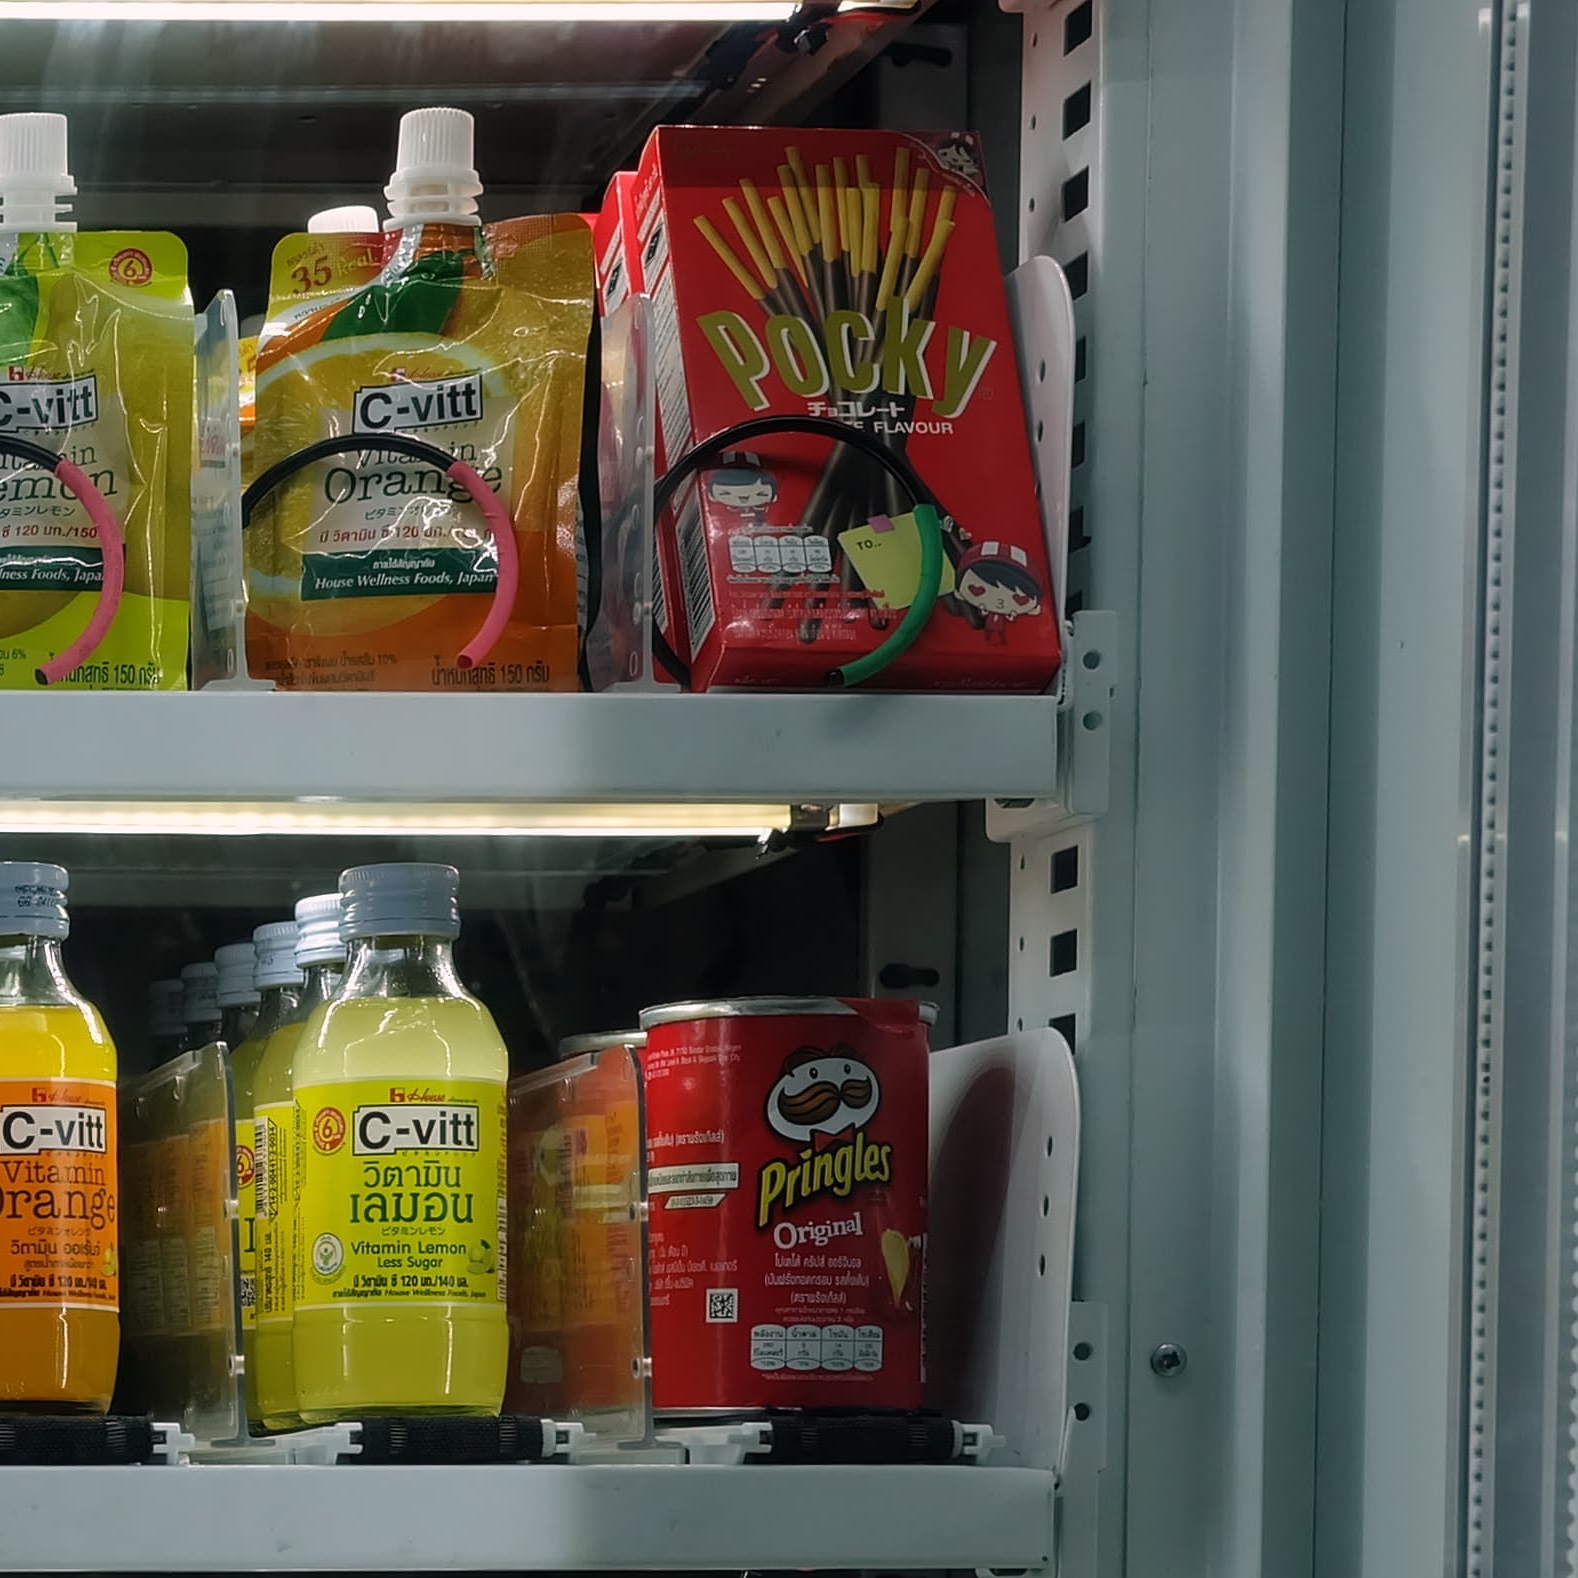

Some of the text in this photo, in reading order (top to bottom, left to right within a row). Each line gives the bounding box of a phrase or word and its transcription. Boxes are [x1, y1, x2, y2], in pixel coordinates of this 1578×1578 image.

[291, 255, 333, 294] 35
[359, 382, 478, 429] C-vitt
[808, 400, 906, 419] チョコレート
[873, 420, 954, 435] FLAVOUR
[15, 524, 38, 536] 120
[333, 526, 419, 542] วิตามิน 120
[31, 568, 71, 583] Foods,
[315, 571, 494, 591] House Wellness Foods, Japan
[114, 665, 135, 683] 150
[500, 666, 523, 685] 150
[407, 1088, 446, 1103] House
[2, 1111, 104, 1150] C-vitt
[359, 1110, 475, 1150] C-vitt
[0, 1160, 106, 1187] Vitamin
[364, 1160, 461, 1188] วิตามิน
[759, 1132, 892, 1228] Pringles
[350, 1192, 474, 1224] เลมอน
[381, 1226, 446, 1236] ビタミンレモン
[773, 1212, 863, 1250] Original
[351, 1239, 467, 1255] Vitamin Lemon
[377, 1256, 444, 1270] Less Sugar
[362, 1274, 419, 1288] วิตามิน 120
